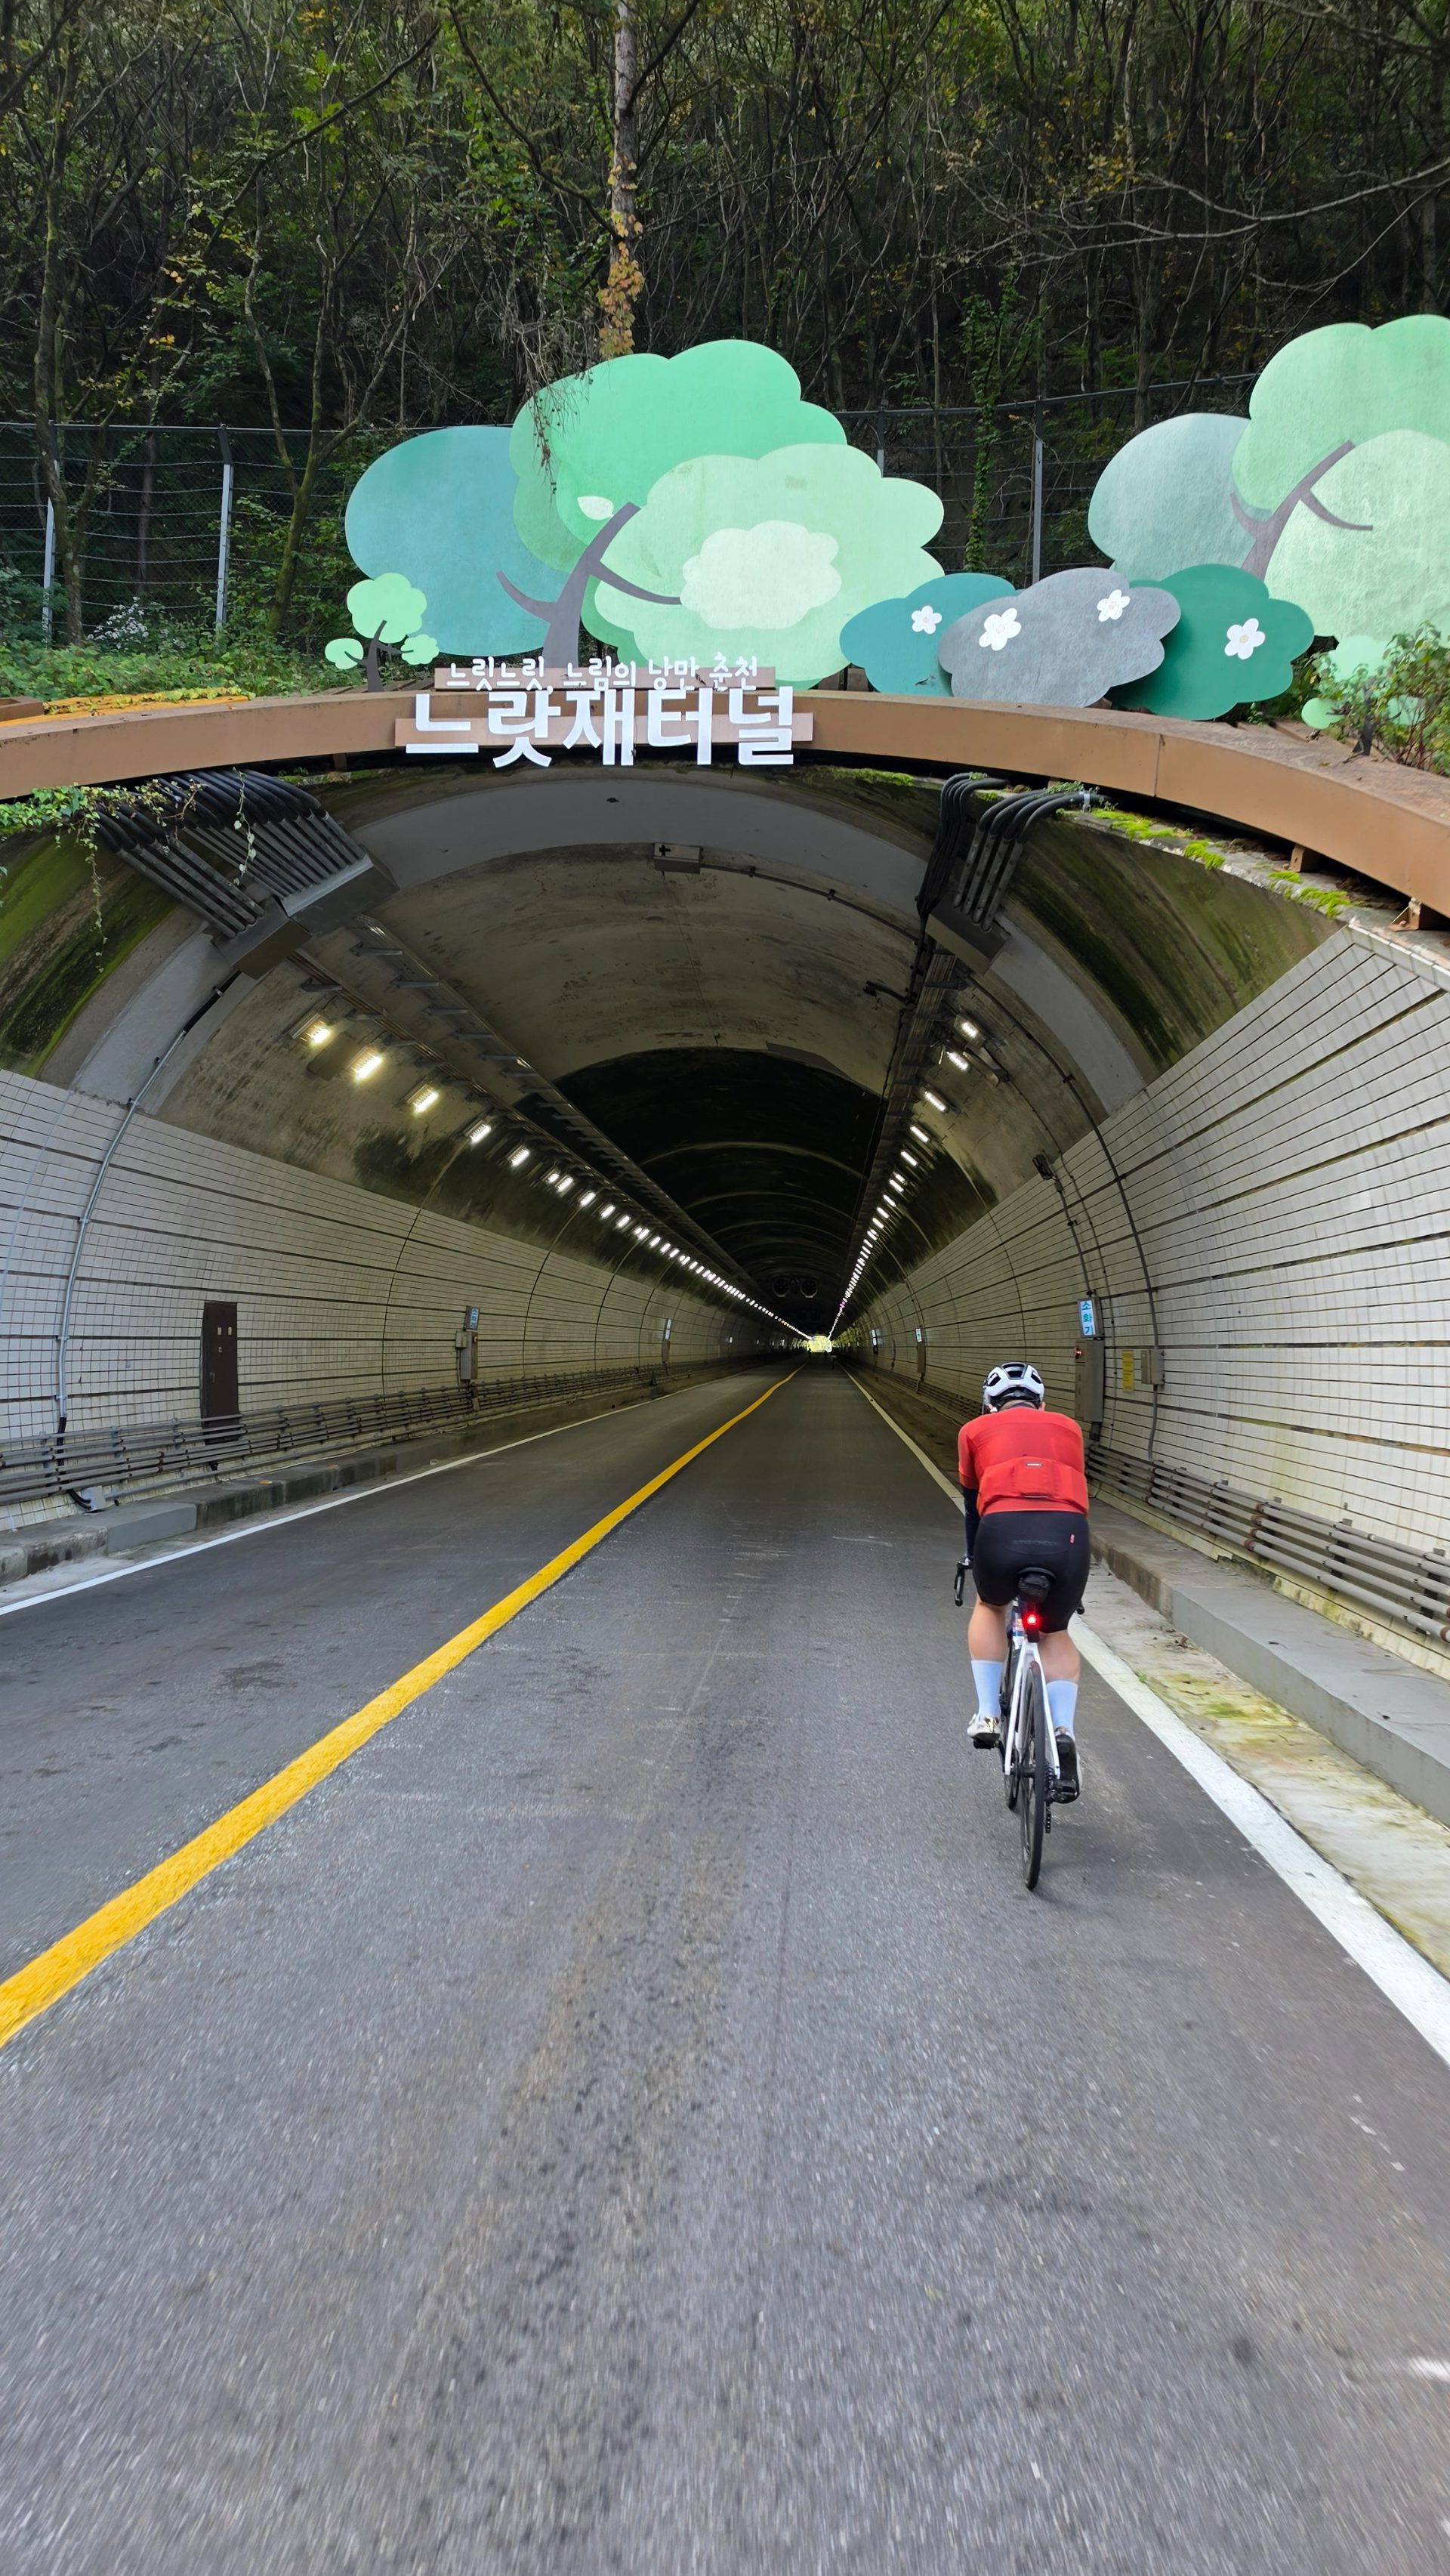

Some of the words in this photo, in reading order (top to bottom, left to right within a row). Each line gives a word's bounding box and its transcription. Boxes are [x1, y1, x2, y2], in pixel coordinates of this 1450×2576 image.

[447, 656, 554, 694] 느릿느릿,
[563, 656, 636, 691] 느림의
[648, 656, 699, 690] 낭만
[709, 652, 757, 692] 춘천
[406, 686, 794, 768] 느랏재터널
[1081, 1300, 1094, 1335] 소화기
